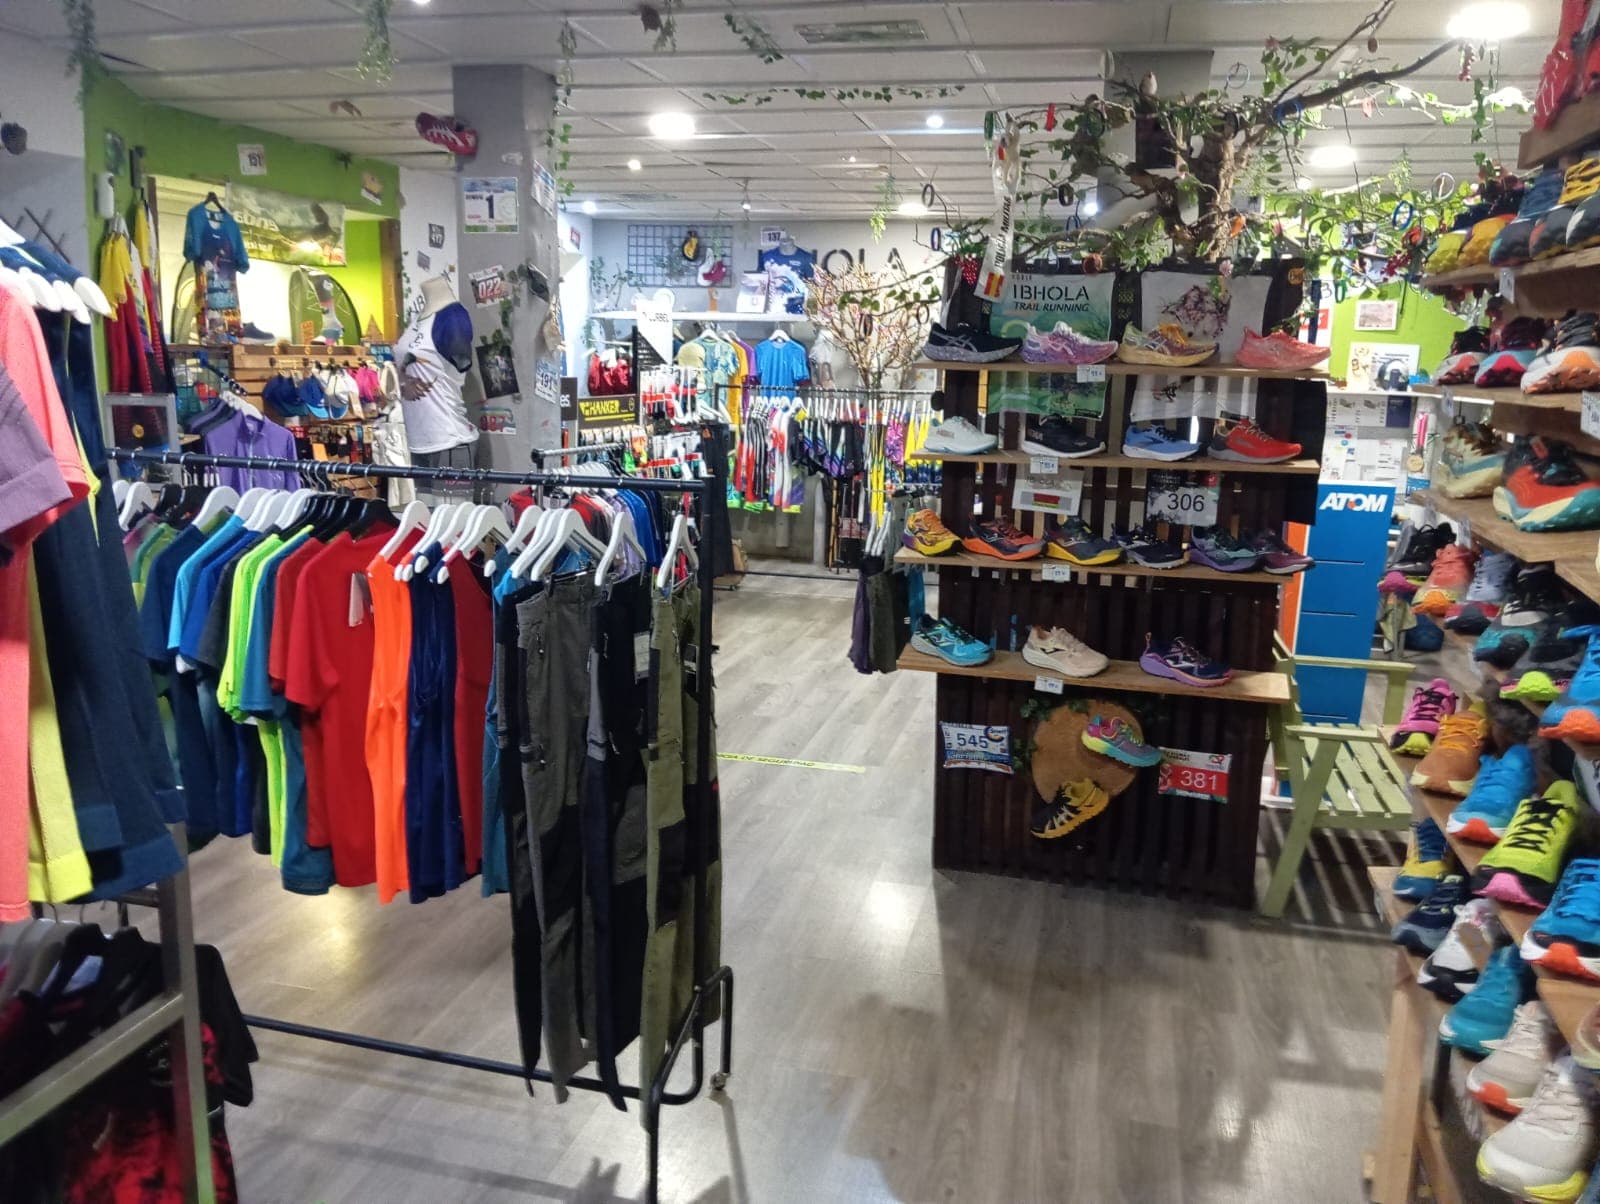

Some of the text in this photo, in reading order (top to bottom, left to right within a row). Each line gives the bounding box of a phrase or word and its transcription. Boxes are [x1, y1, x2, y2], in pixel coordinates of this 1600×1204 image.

[485, 195, 494, 219] 1
[479, 278, 502, 299] 022
[1013, 284, 1090, 301] IBHOLA
[1014, 301, 1090, 312] TRAIL RUNNING
[1167, 493, 1205, 513] 306
[1319, 492, 1389, 513] ATOM
[956, 732, 989, 749] 545
[1180, 770, 1217, 791] 381
